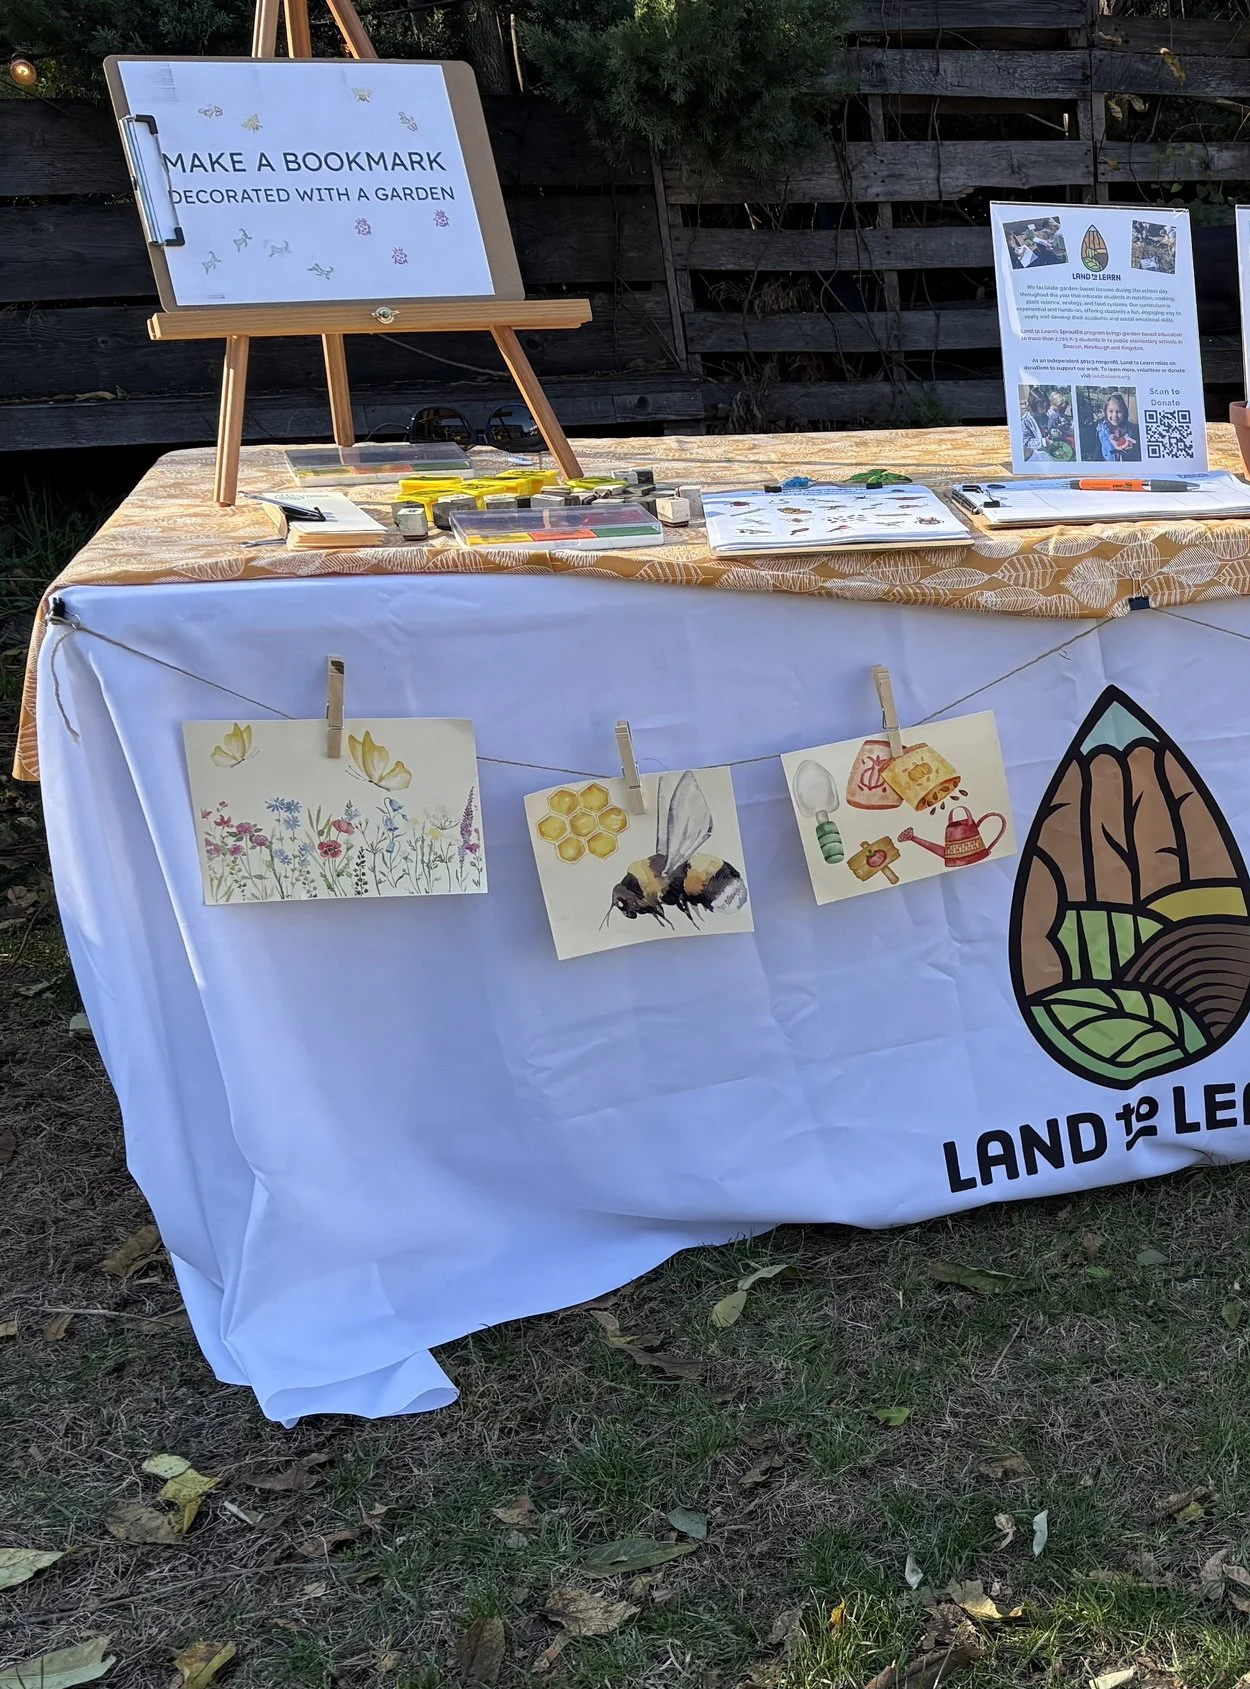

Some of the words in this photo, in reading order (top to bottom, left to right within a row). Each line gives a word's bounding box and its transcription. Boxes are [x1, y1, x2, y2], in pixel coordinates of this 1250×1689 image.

[162, 152, 245, 174] MAKE
[256, 153, 276, 172] A
[284, 151, 447, 172] BOOKMARK
[168, 188, 290, 205] DECORATED
[295, 187, 350, 202] WITH
[356, 187, 371, 201] A
[374, 186, 455, 201] GARDEN
[1150, 399, 1180, 407] Donate
[942, 1112, 1108, 1193] LAND
[1115, 1096, 1159, 1145] to
